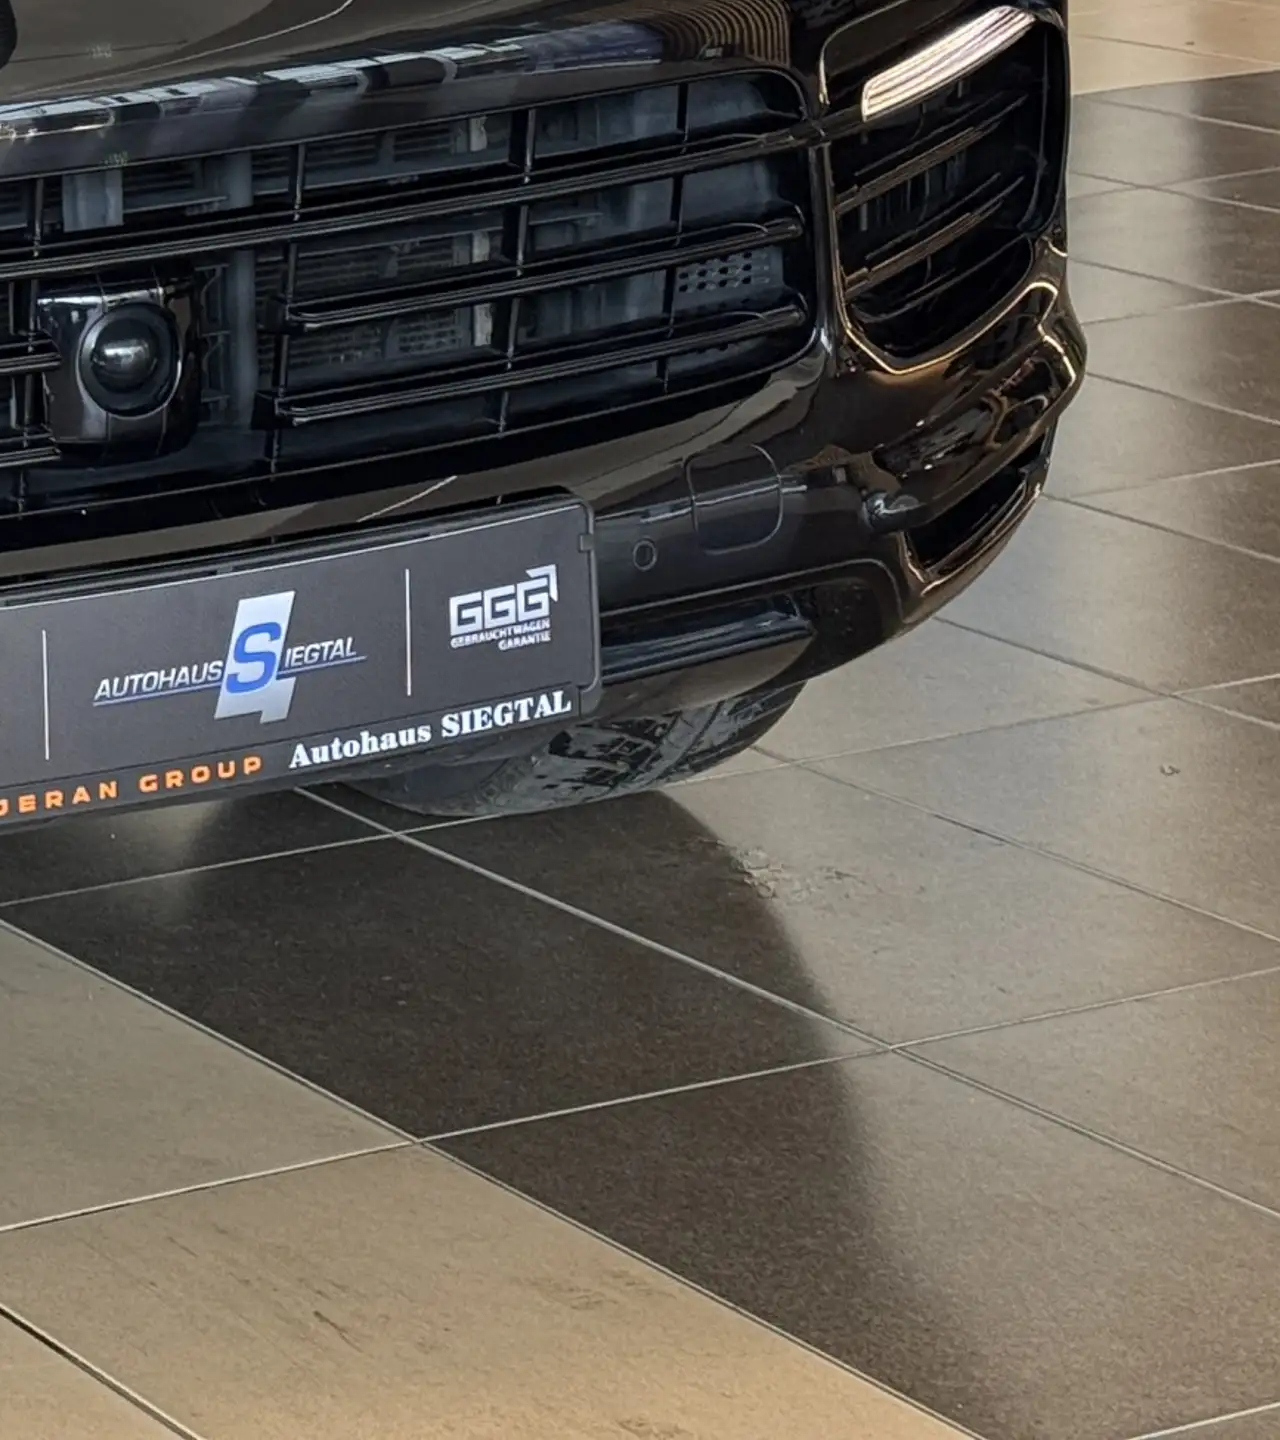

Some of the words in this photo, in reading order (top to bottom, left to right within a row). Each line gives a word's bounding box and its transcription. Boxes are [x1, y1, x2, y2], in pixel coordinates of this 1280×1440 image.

[450, 575, 552, 636] GGG
[450, 618, 551, 649] GEBRAUCHTWAGEN
[498, 630, 551, 651] GARANTIE
[94, 660, 223, 701] AUTOHAUS
[138, 755, 263, 793] GROUP
[289, 724, 432, 769] Autohaus
[441, 690, 572, 738] SIEGTAL
